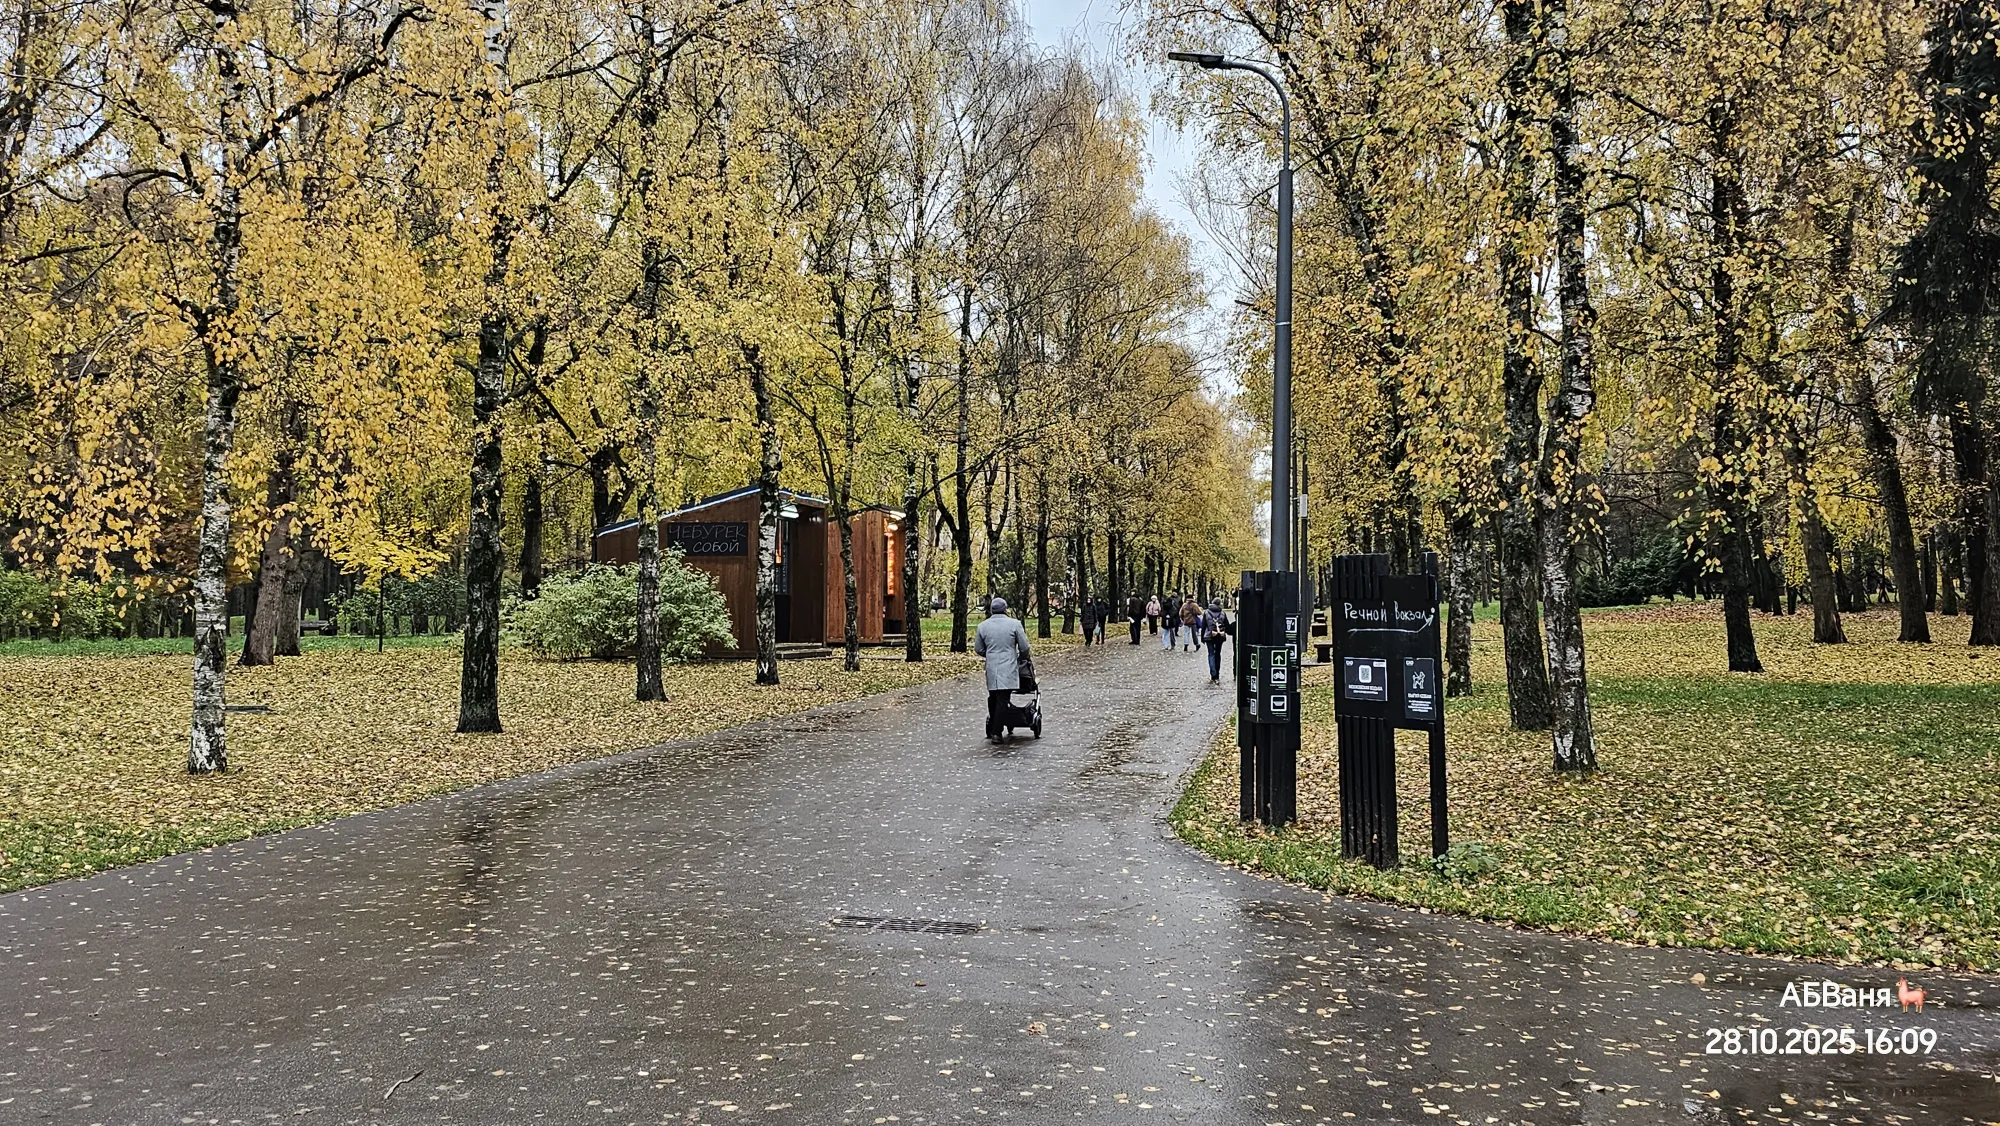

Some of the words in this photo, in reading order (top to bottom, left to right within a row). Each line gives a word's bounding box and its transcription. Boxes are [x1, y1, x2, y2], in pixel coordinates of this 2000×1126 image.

[669, 525, 746, 539] ЧЕБУРЕК
[693, 539, 739, 553] СОБОЙ
[1344, 601, 1387, 622] Речной
